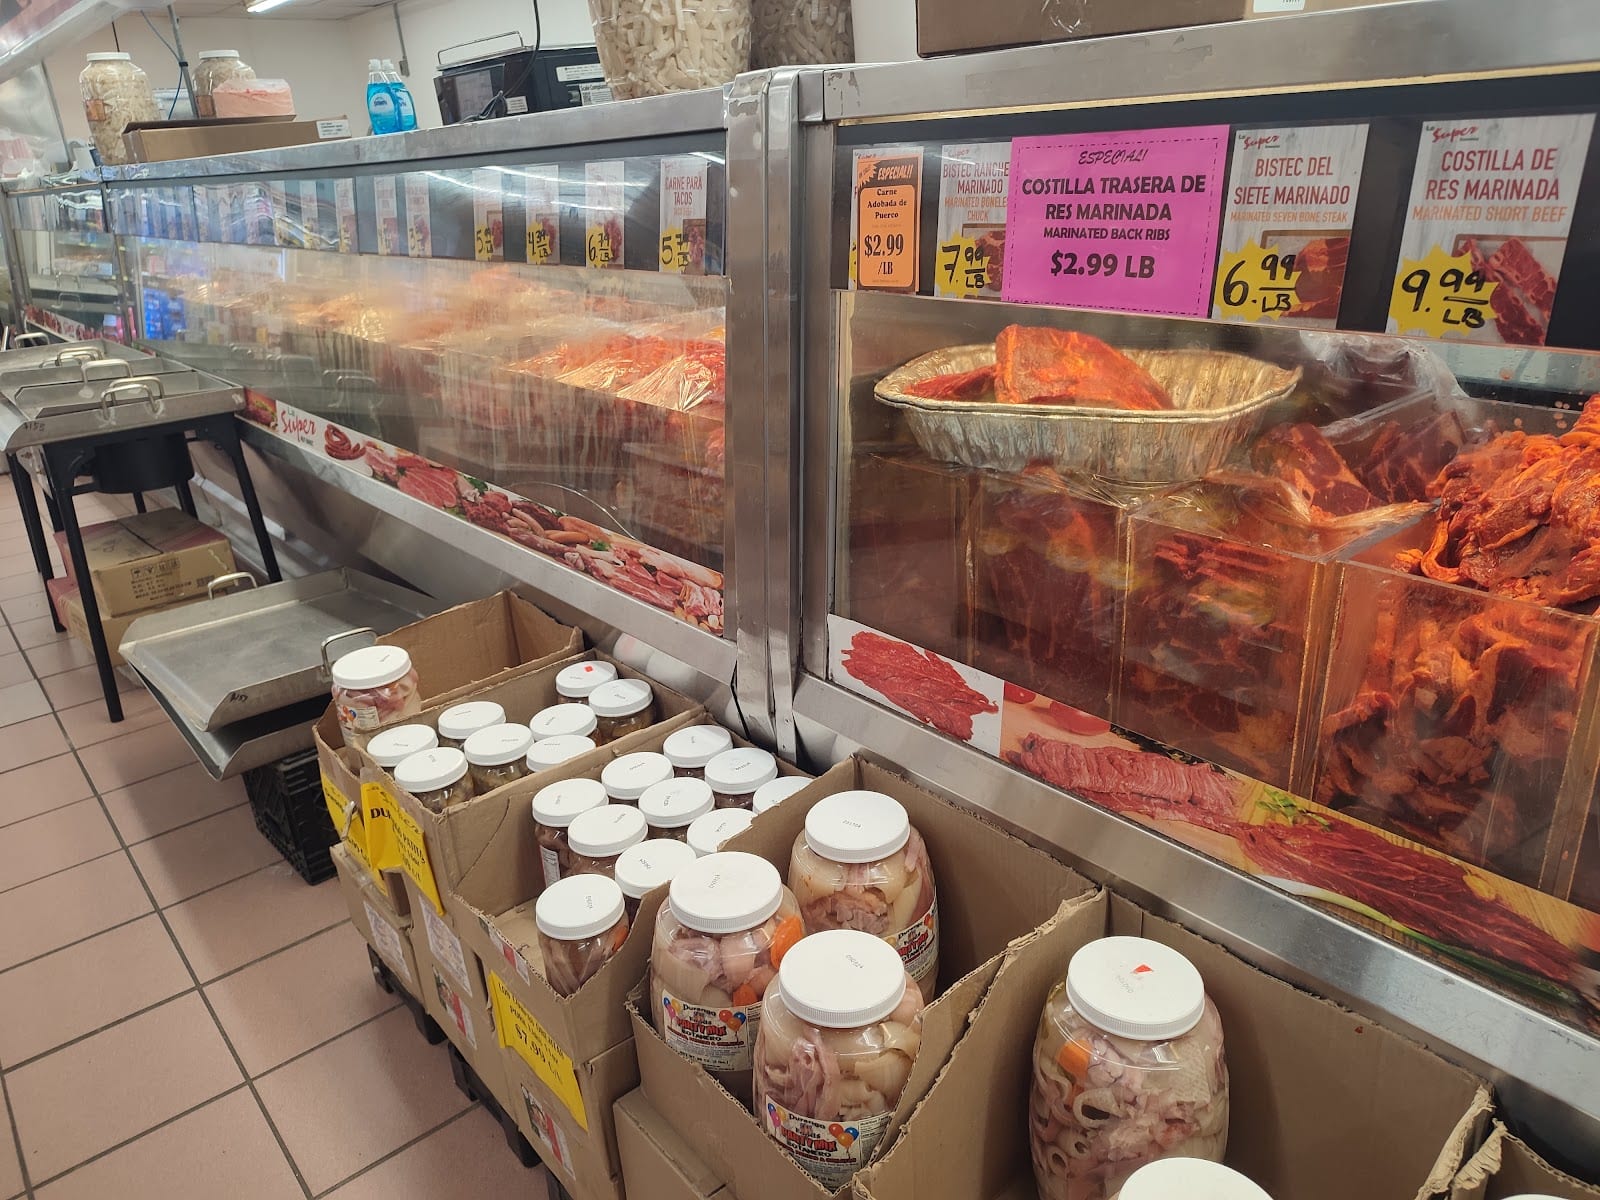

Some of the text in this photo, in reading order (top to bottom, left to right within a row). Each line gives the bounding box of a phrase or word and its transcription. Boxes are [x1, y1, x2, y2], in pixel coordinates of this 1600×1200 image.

[1432, 125, 1479, 143] Super
[1078, 149, 1149, 165] ESPECIAL!
[1441, 148, 1558, 172] COSTILLA DE
[943, 163, 971, 178] BISTEC
[1255, 156, 1333, 177] BISTEC DEL
[665, 176, 685, 190] CARNE
[686, 176, 703, 190] PARA
[957, 179, 1003, 195] MARINADO
[1022, 175, 1206, 195] COSTILLA TRASERA DE
[1425, 178, 1559, 200] RES MARINADA
[674, 191, 693, 206] TACOS
[876, 188, 898, 196] Carne
[1233, 185, 1350, 205] SIETE MARINADO
[867, 199, 908, 208] Adobada de
[944, 196, 1007, 208] MARINATED BONELE
[967, 210, 989, 221] CHUCK
[1045, 203, 1172, 221] RES MARINADA
[1230, 211, 1348, 223] MARINATED SEVEN BONE STEAK
[1412, 205, 1568, 222] MARINATED SHORT BEEF
[1043, 227, 1170, 241] MARINATED BACK RIBS
[864, 234, 904, 258] $2.99
[877, 261, 893, 275] /LB
[1050, 249, 1155, 279] $2.99 LB
[966, 274, 985, 289] LB
[1261, 293, 1291, 312] LB
[1442, 307, 1486, 329] LB
[281, 410, 316, 442] Super
[683, 1003, 717, 1017] Durango
[788, 1113, 826, 1130] Durango
